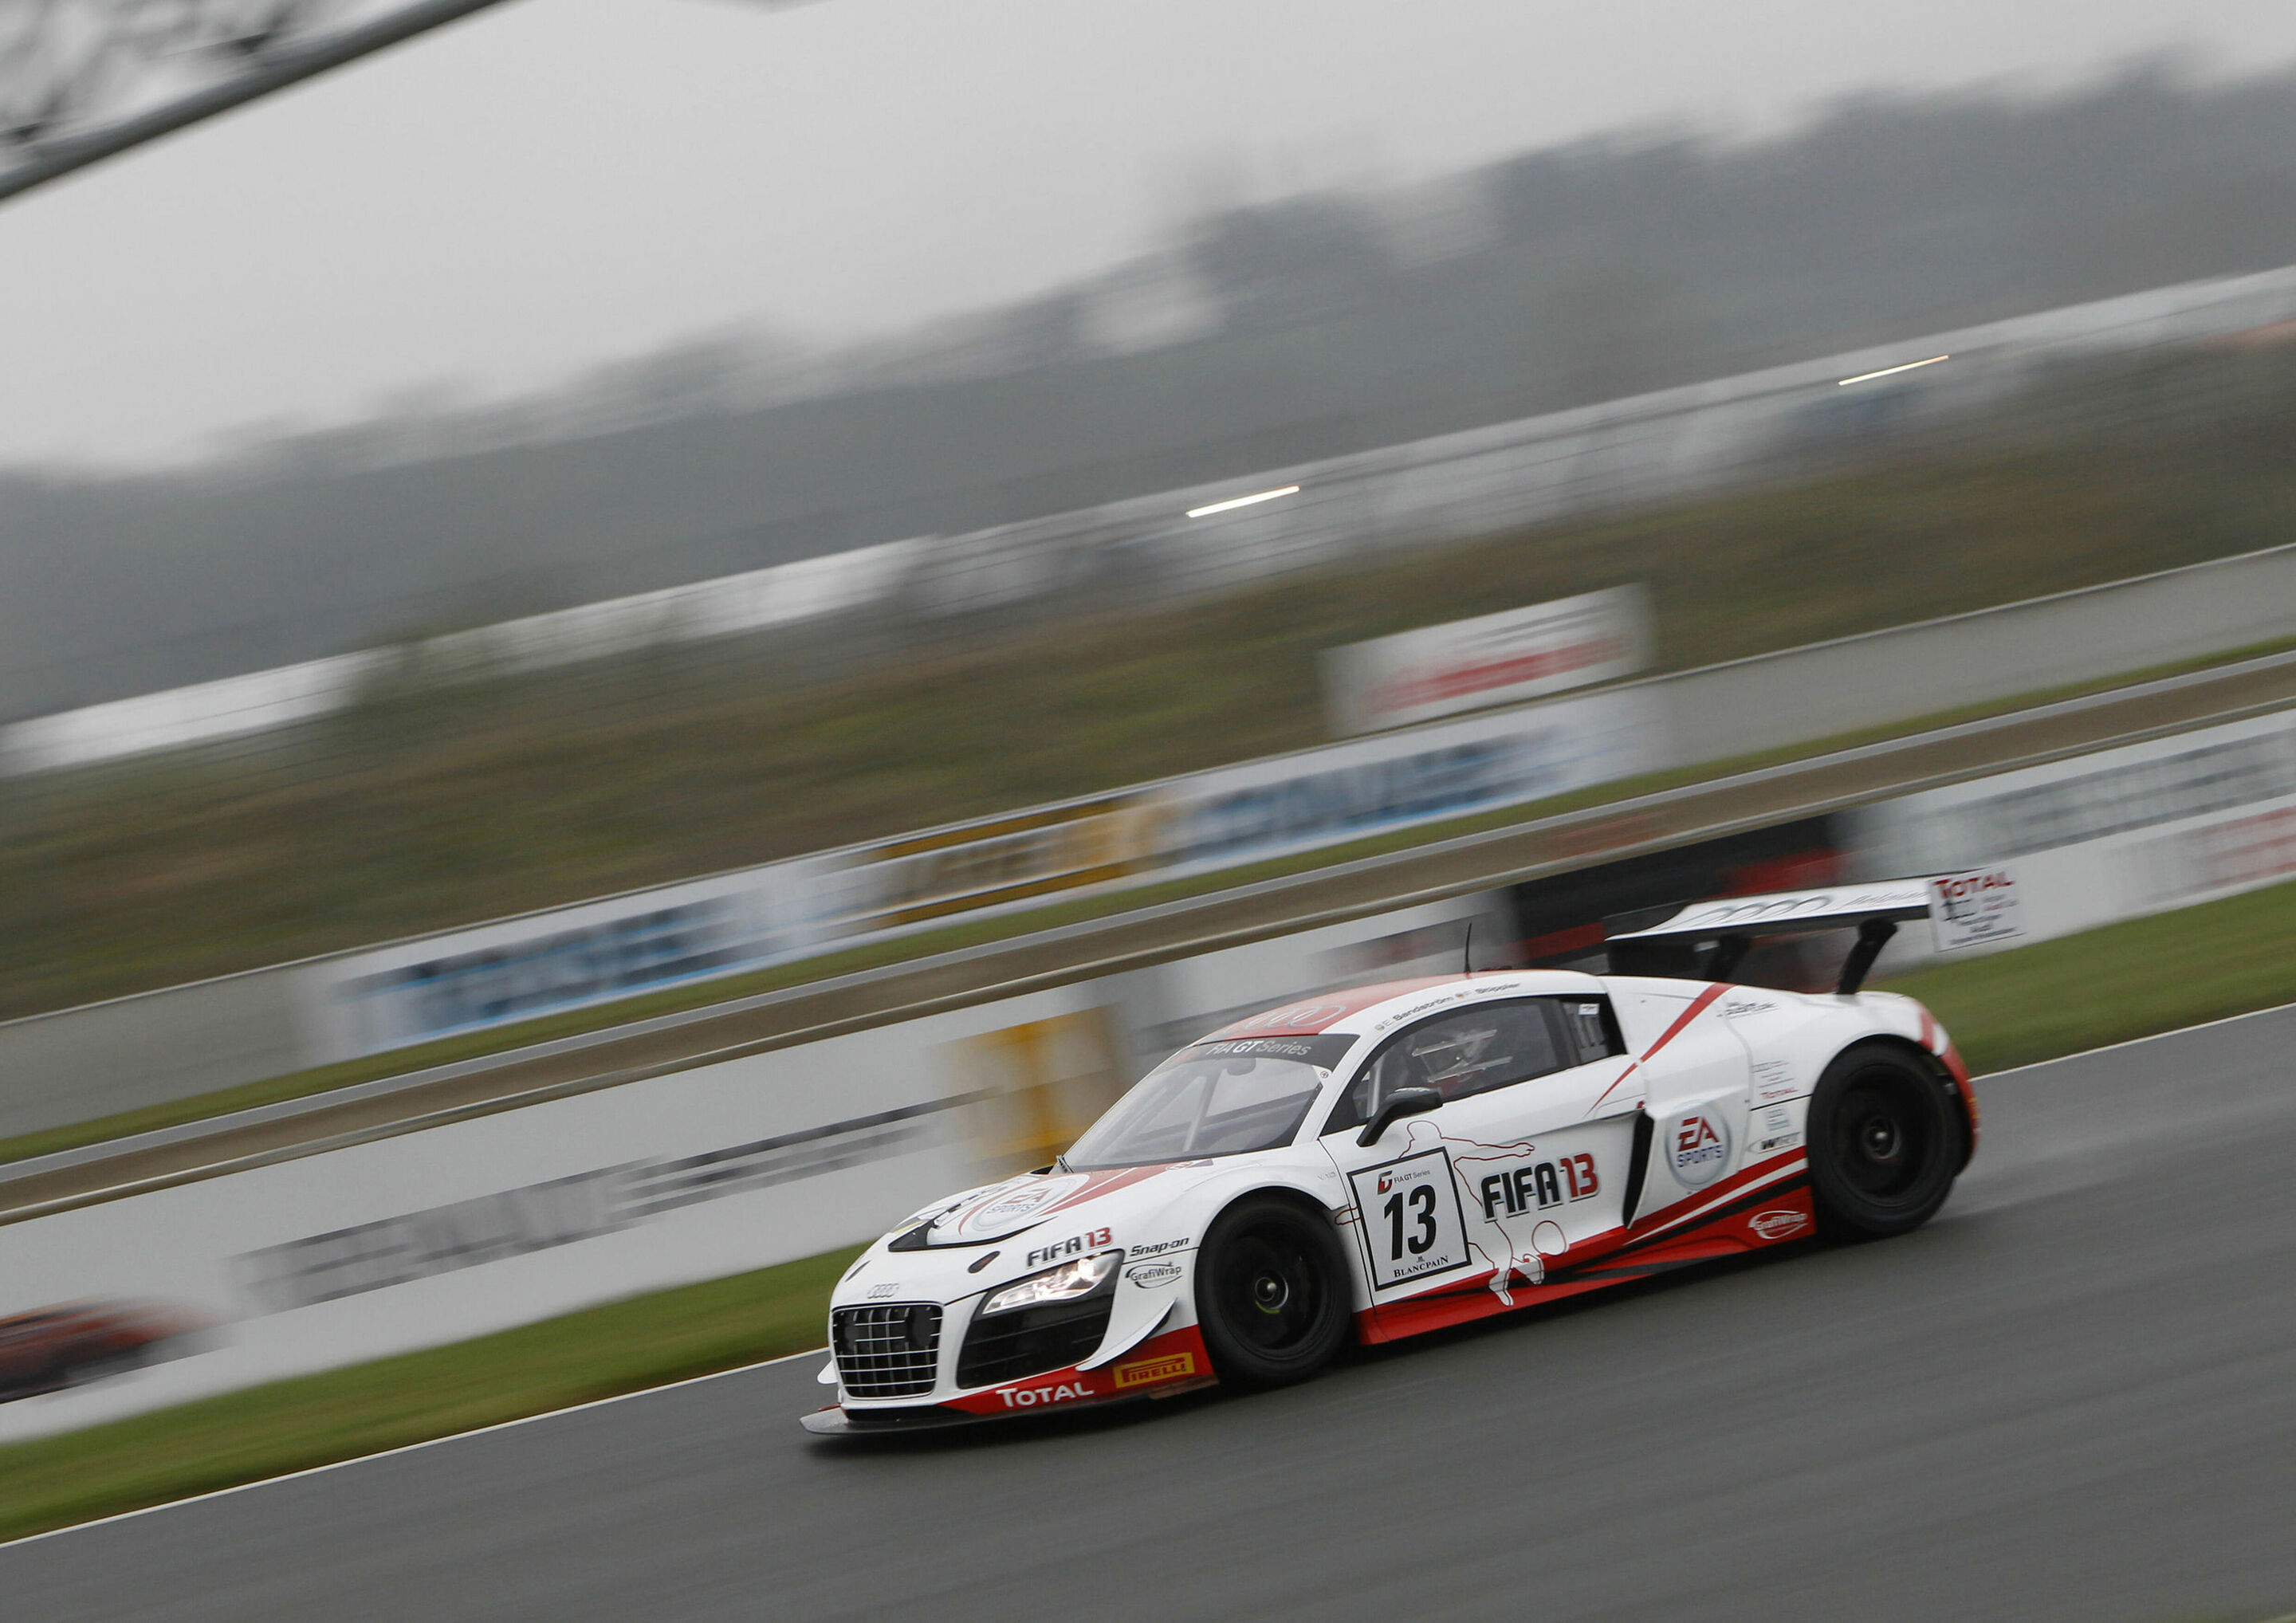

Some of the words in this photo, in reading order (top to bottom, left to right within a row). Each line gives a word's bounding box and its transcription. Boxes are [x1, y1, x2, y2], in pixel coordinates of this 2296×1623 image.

[1933, 872, 2015, 898] TOTAL
[1233, 1040, 1264, 1054] GT
[1256, 1040, 1312, 1056] Series
[1677, 1116, 1720, 1152] EA
[1677, 1145, 1722, 1167] SPORTS
[1413, 1169, 1431, 1179] Series
[1480, 1161, 1563, 1223] FIFA
[1560, 1153, 1600, 1202] 13
[1383, 1185, 1437, 1261] 13
[1026, 1237, 1083, 1269] FIFA
[1084, 1227, 1112, 1248] 13
[1130, 1237, 1189, 1256] Snap-on
[1130, 1266, 1181, 1281] GrafiWrap
[1394, 1256, 1449, 1277] BLANCPAIN
[1122, 1357, 1186, 1383] PIRELLI
[996, 1381, 1095, 1408] TOTAL
